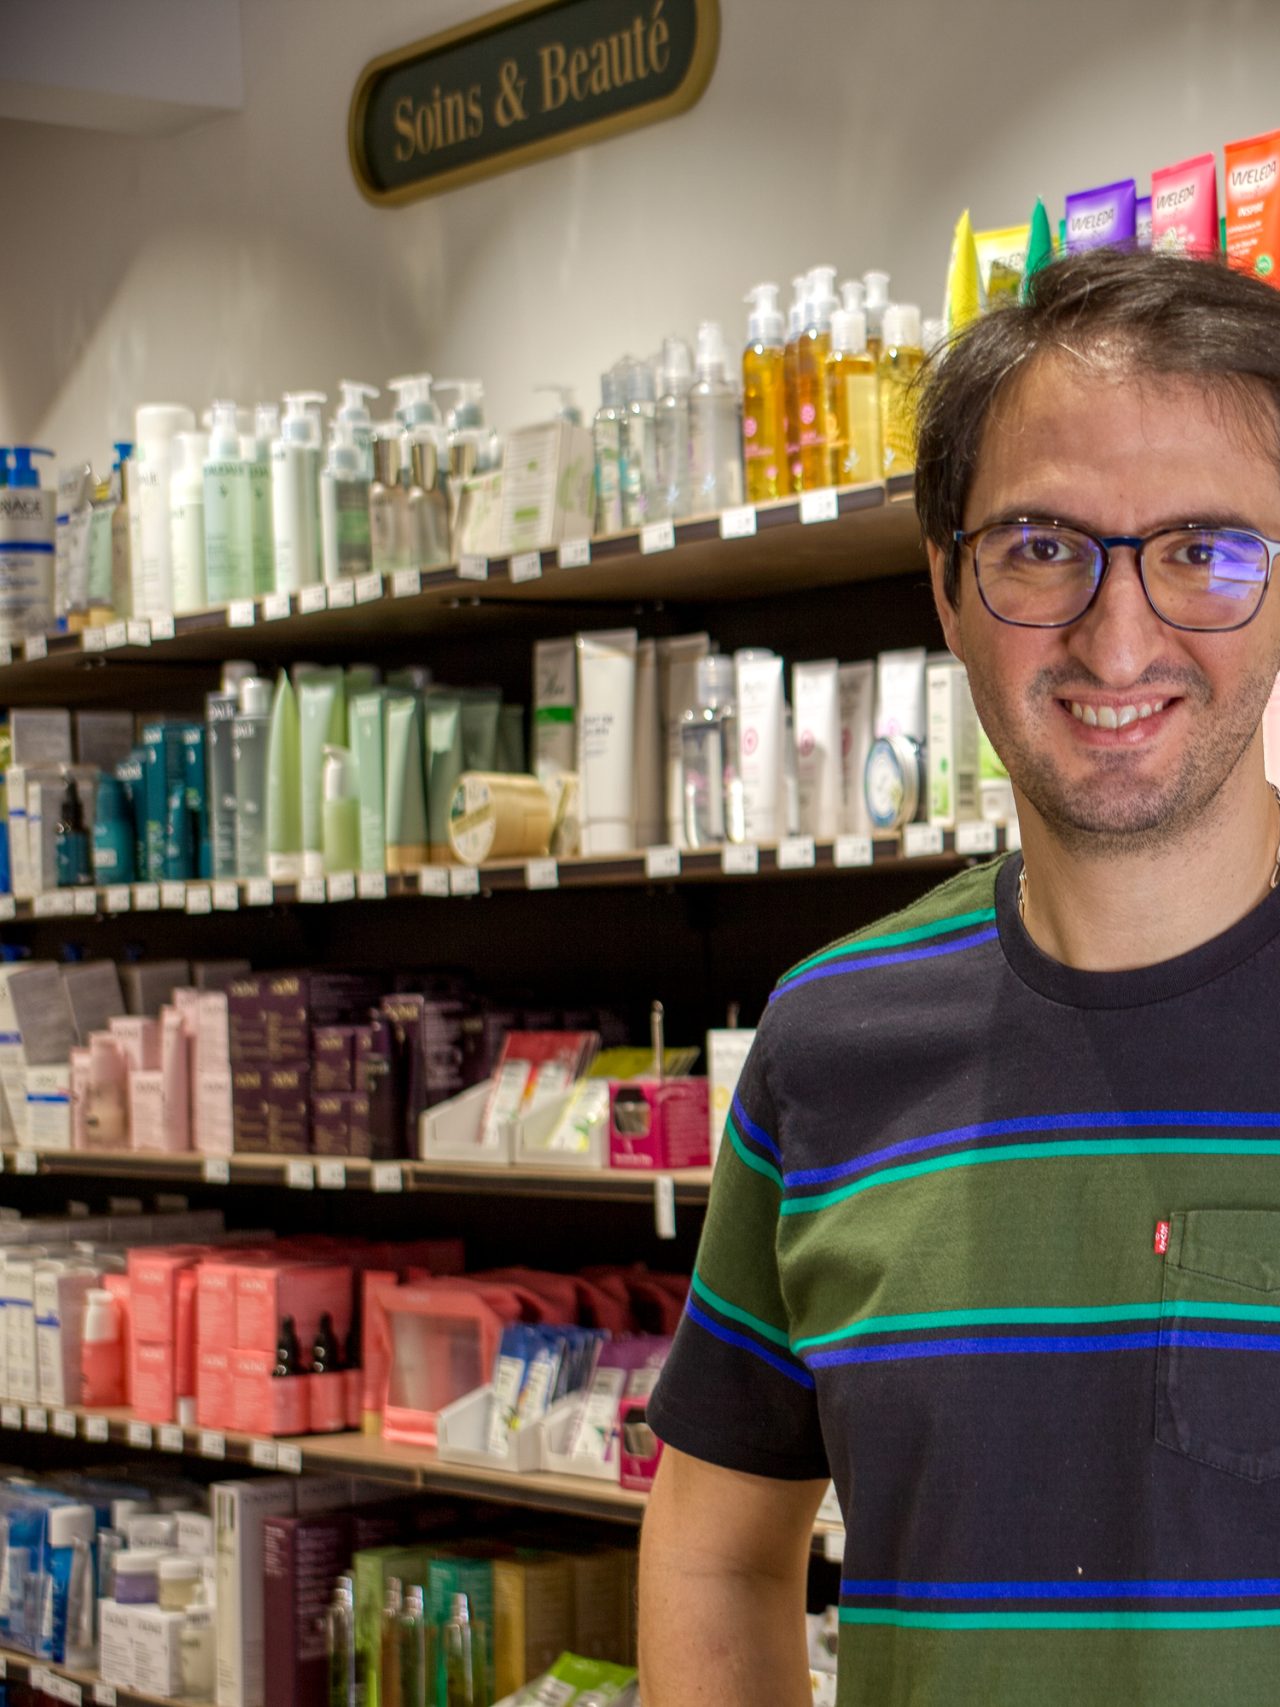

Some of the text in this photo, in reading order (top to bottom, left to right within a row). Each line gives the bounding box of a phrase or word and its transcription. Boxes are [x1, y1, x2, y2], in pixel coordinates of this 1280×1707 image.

[394, 1, 670, 161] Soins & Beauté
[1231, 160, 1277, 186] WELEDA
[1156, 185, 1195, 209] WELEDA
[1071, 207, 1114, 230] WELEDA
